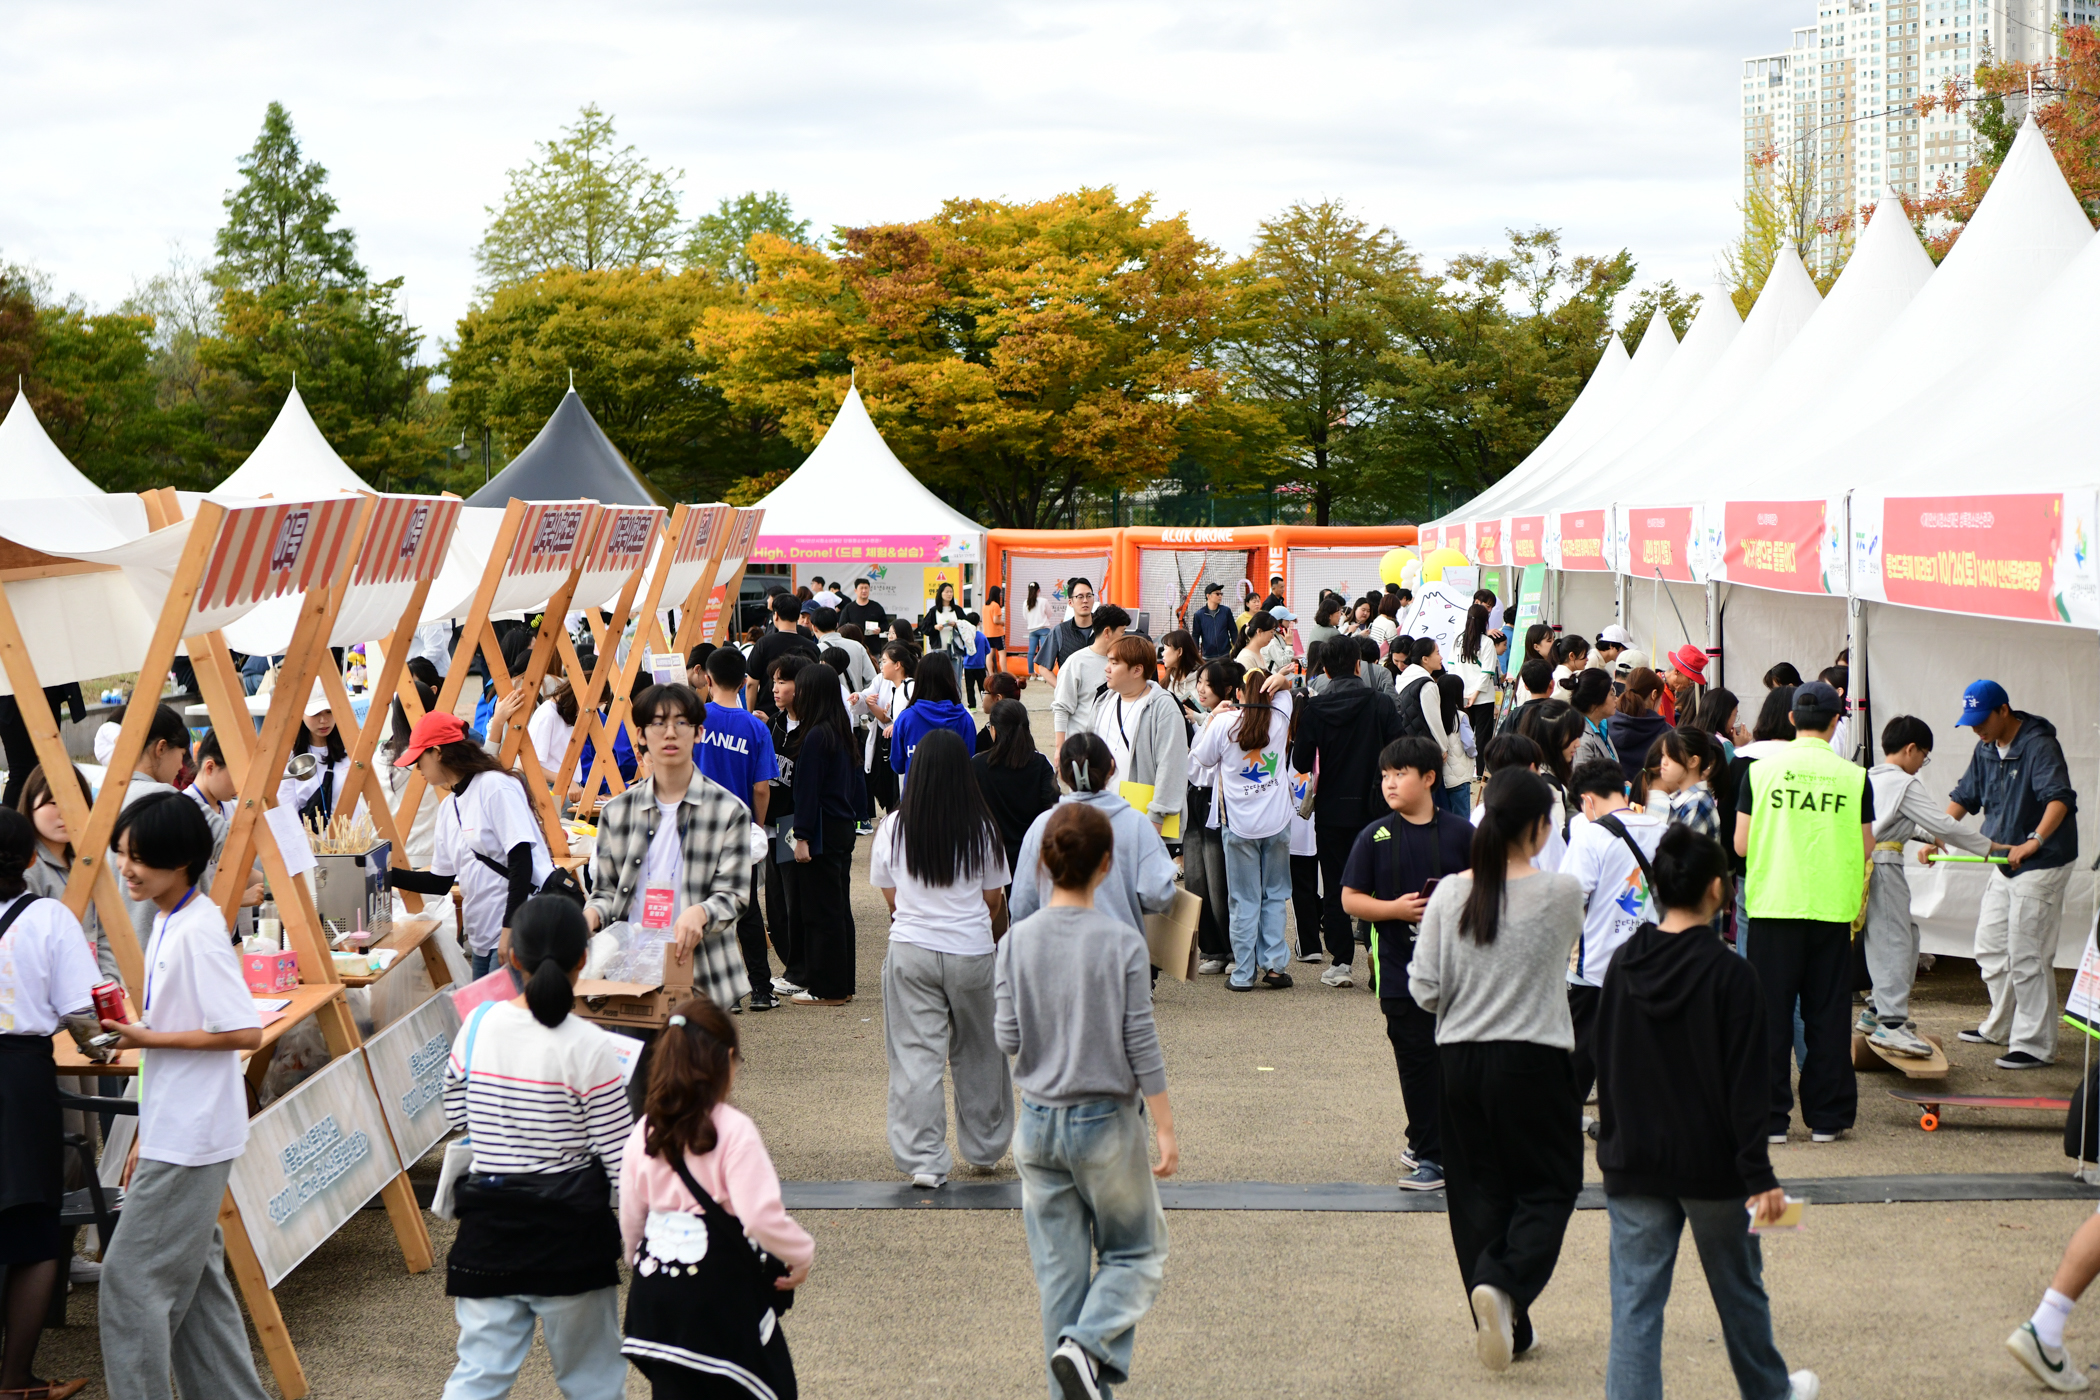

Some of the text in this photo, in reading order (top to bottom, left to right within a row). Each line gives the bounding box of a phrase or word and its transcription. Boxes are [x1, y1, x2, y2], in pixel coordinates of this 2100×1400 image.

[271, 508, 310, 574] 어묵
[401, 505, 429, 560] 어묵
[1194, 528, 1234, 543] DRONE
[754, 546, 924, 560] High, Drone! (드론 체험&실습)
[1938, 550, 1977, 588] 10/26(토)
[1997, 559, 2043, 592] 안산문화광장
[1771, 789, 1847, 813] STAFF
